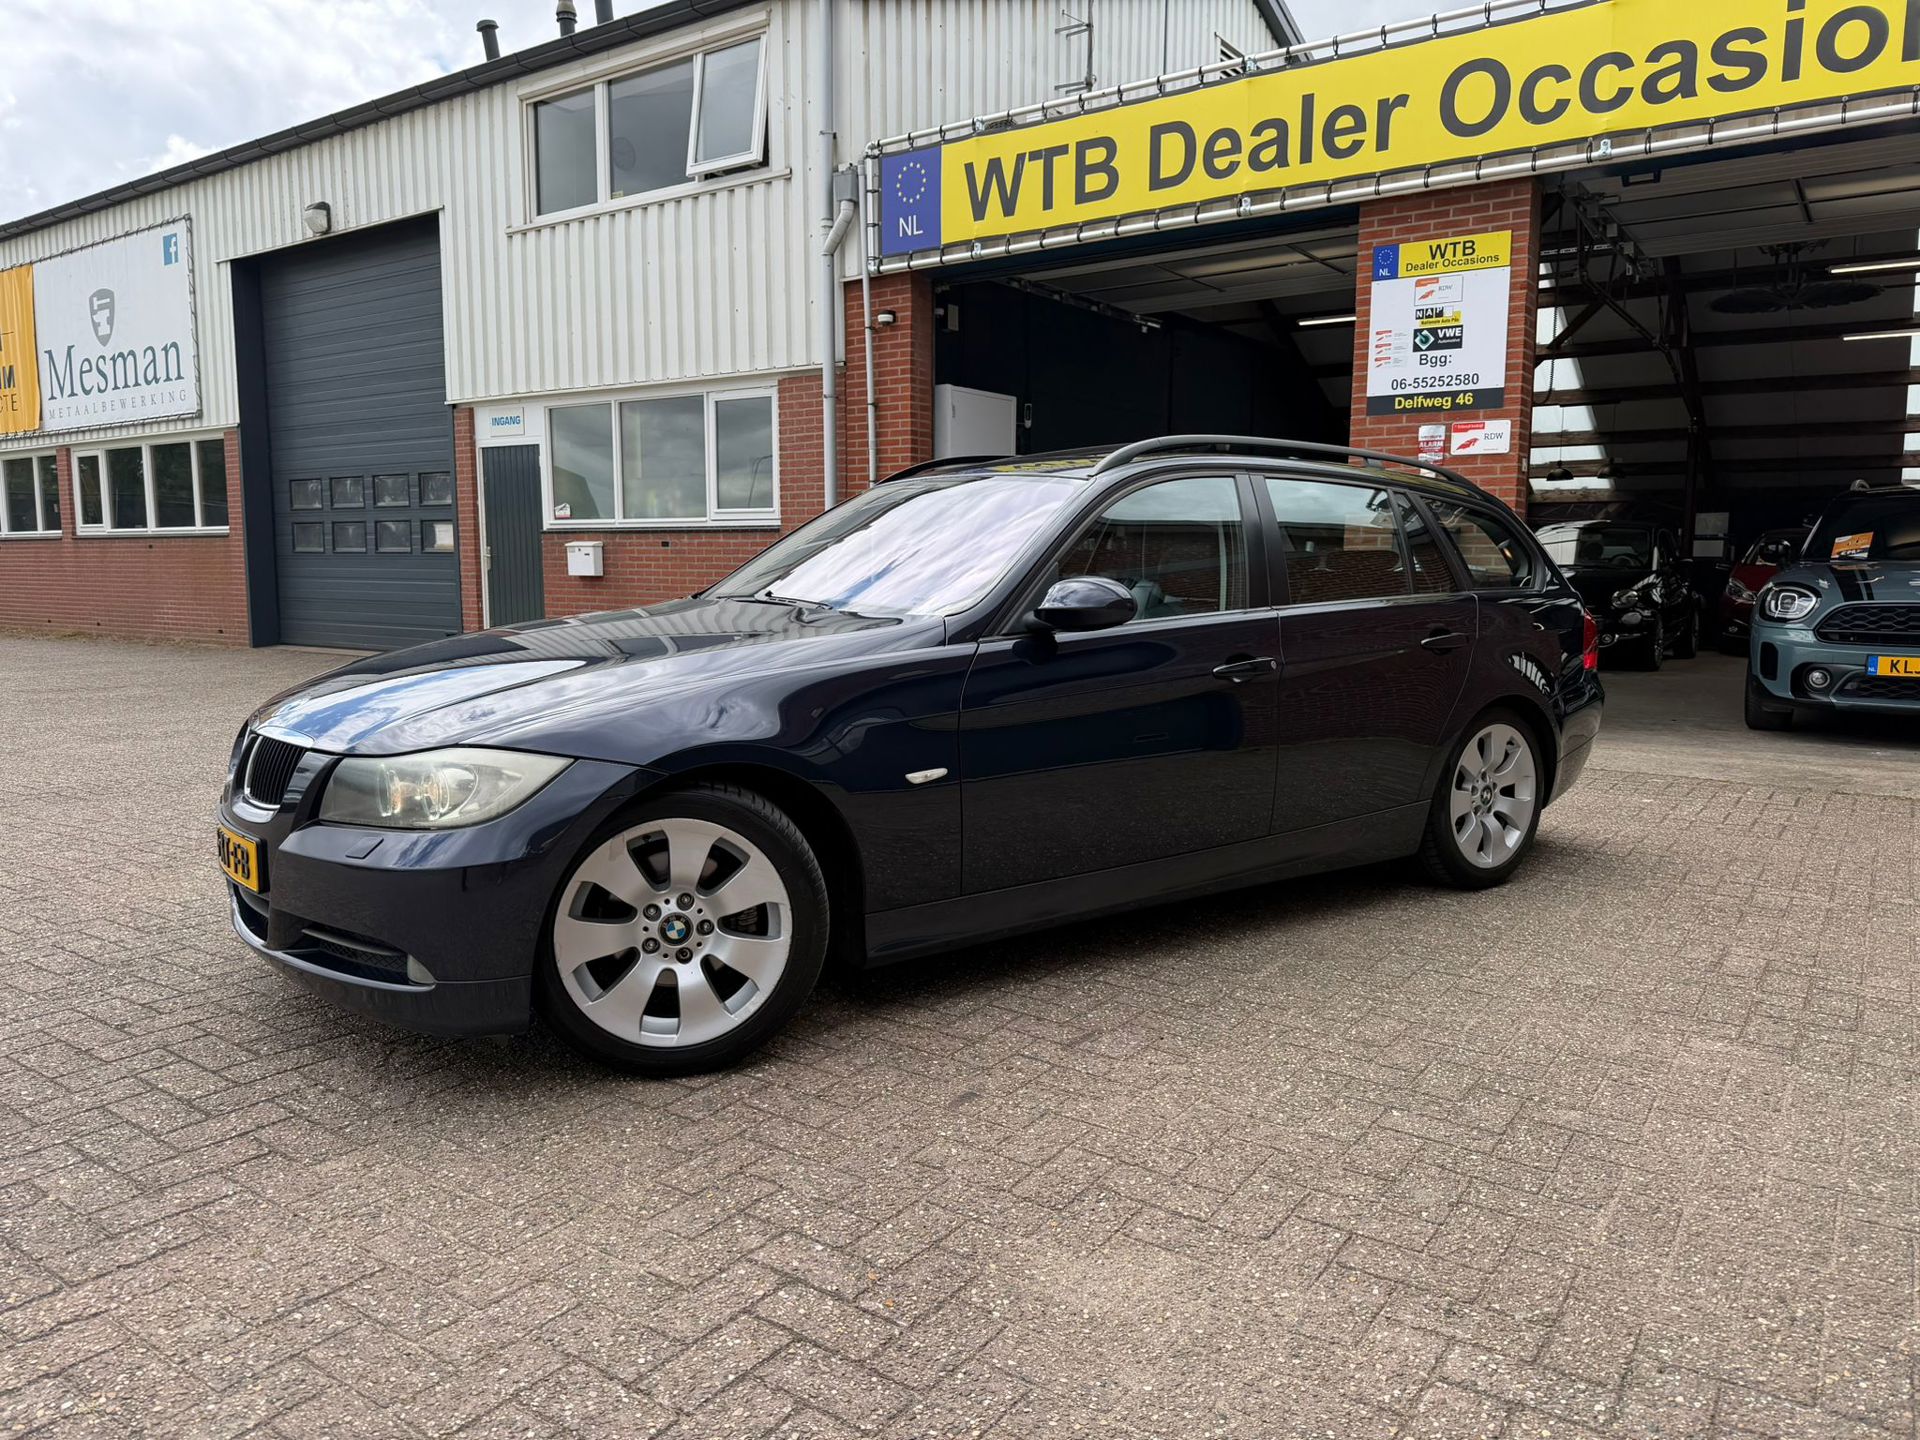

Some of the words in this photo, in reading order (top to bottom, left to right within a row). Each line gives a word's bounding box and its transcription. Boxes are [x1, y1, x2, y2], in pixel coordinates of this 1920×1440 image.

[964, 136, 1120, 222] WTB
[1149, 93, 1410, 192] Dealer
[899, 215, 923, 238] NL
[1429, 240, 1476, 260] WTB
[1406, 261, 1439, 272] Dealer
[1442, 254, 1499, 268] Occasions
[1379, 268, 1391, 277] NL
[1438, 328, 1462, 338] VWE
[1419, 354, 1452, 368] Bgg:
[0, 365, 15, 389] M
[44, 341, 185, 400] Mesman
[1391, 373, 1480, 390] 06-55252580
[49, 389, 187, 419] METAALBEWERKING
[1394, 395, 1452, 410] Delfweg
[1456, 392, 1474, 405] 46
[491, 415, 521, 426] INGANG
[1419, 440, 1444, 448] ALARM
[1483, 432, 1504, 440] RDW
